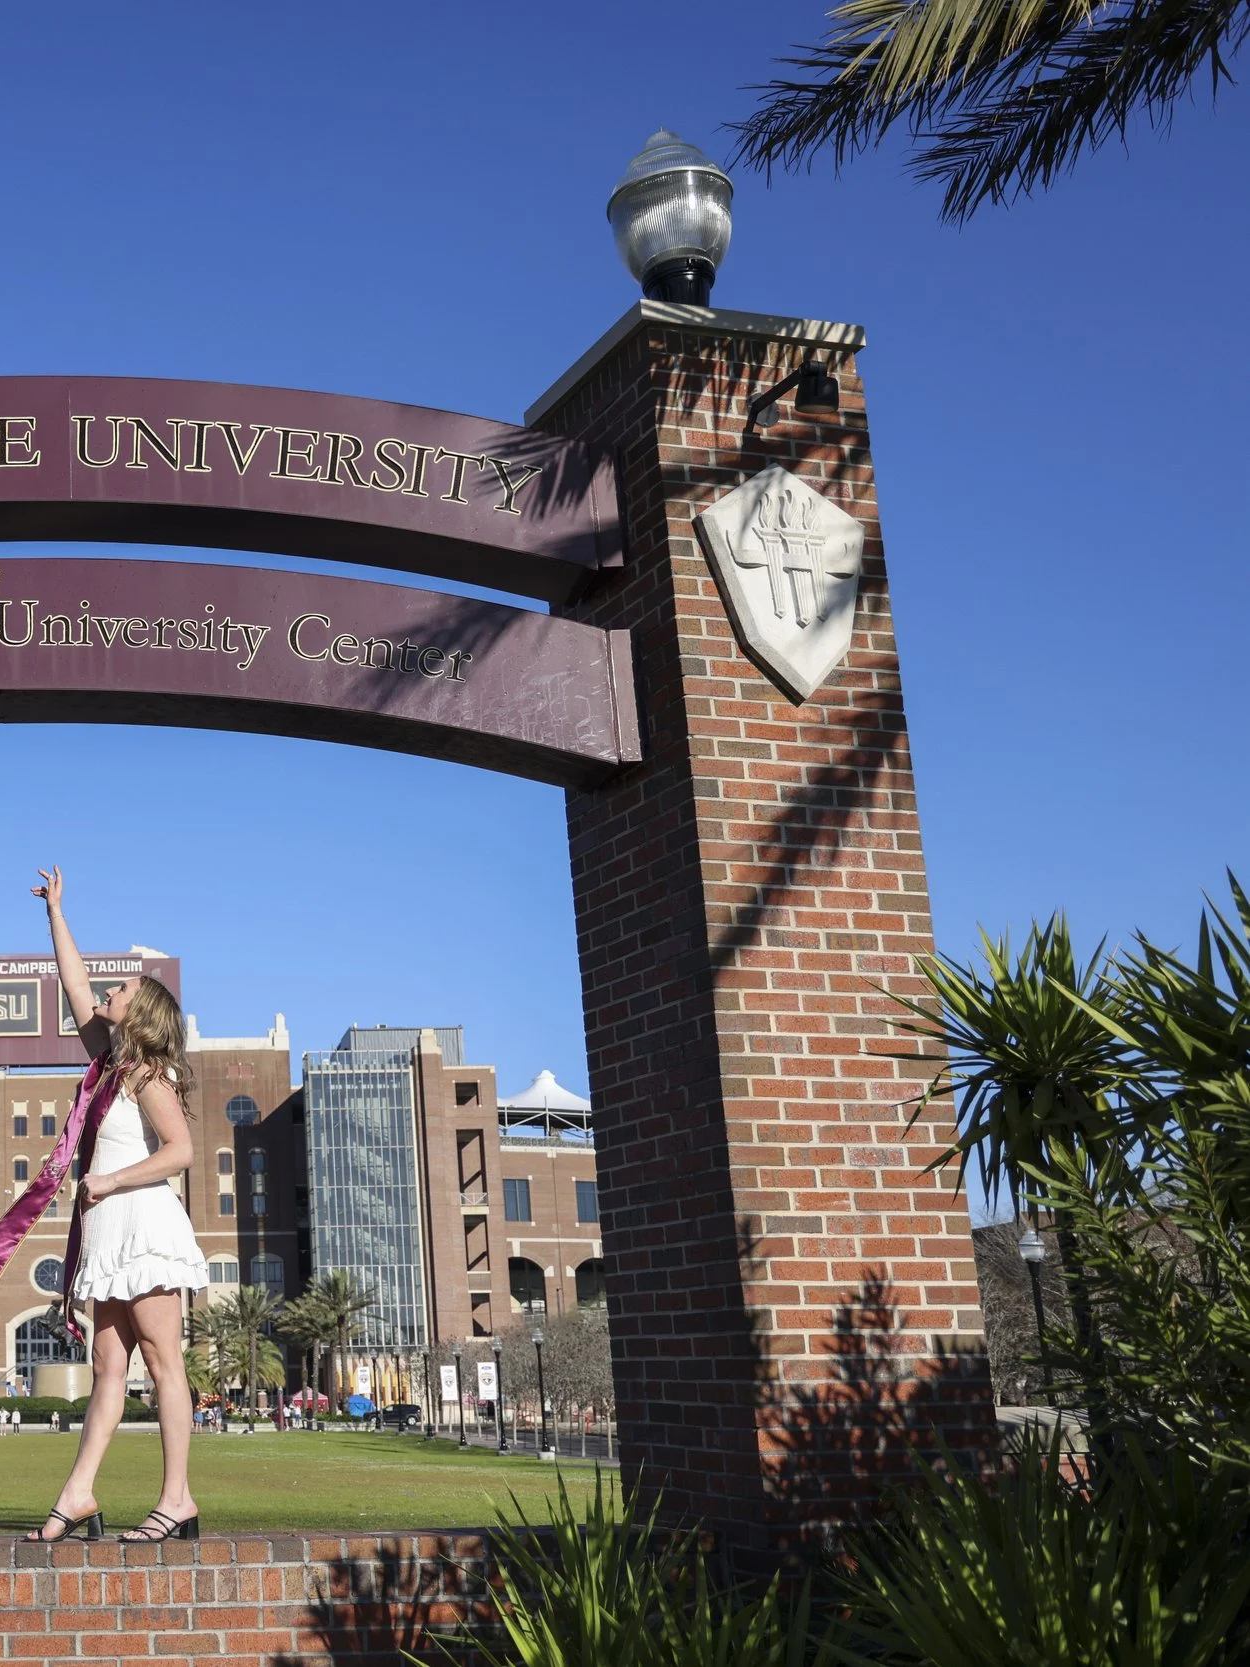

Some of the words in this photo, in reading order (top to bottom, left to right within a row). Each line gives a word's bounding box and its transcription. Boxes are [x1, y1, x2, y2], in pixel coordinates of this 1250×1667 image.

[70, 415, 542, 515] UNIVERSITY
[286, 613, 473, 683] Center
[0, 961, 60, 975] CAMPBE
